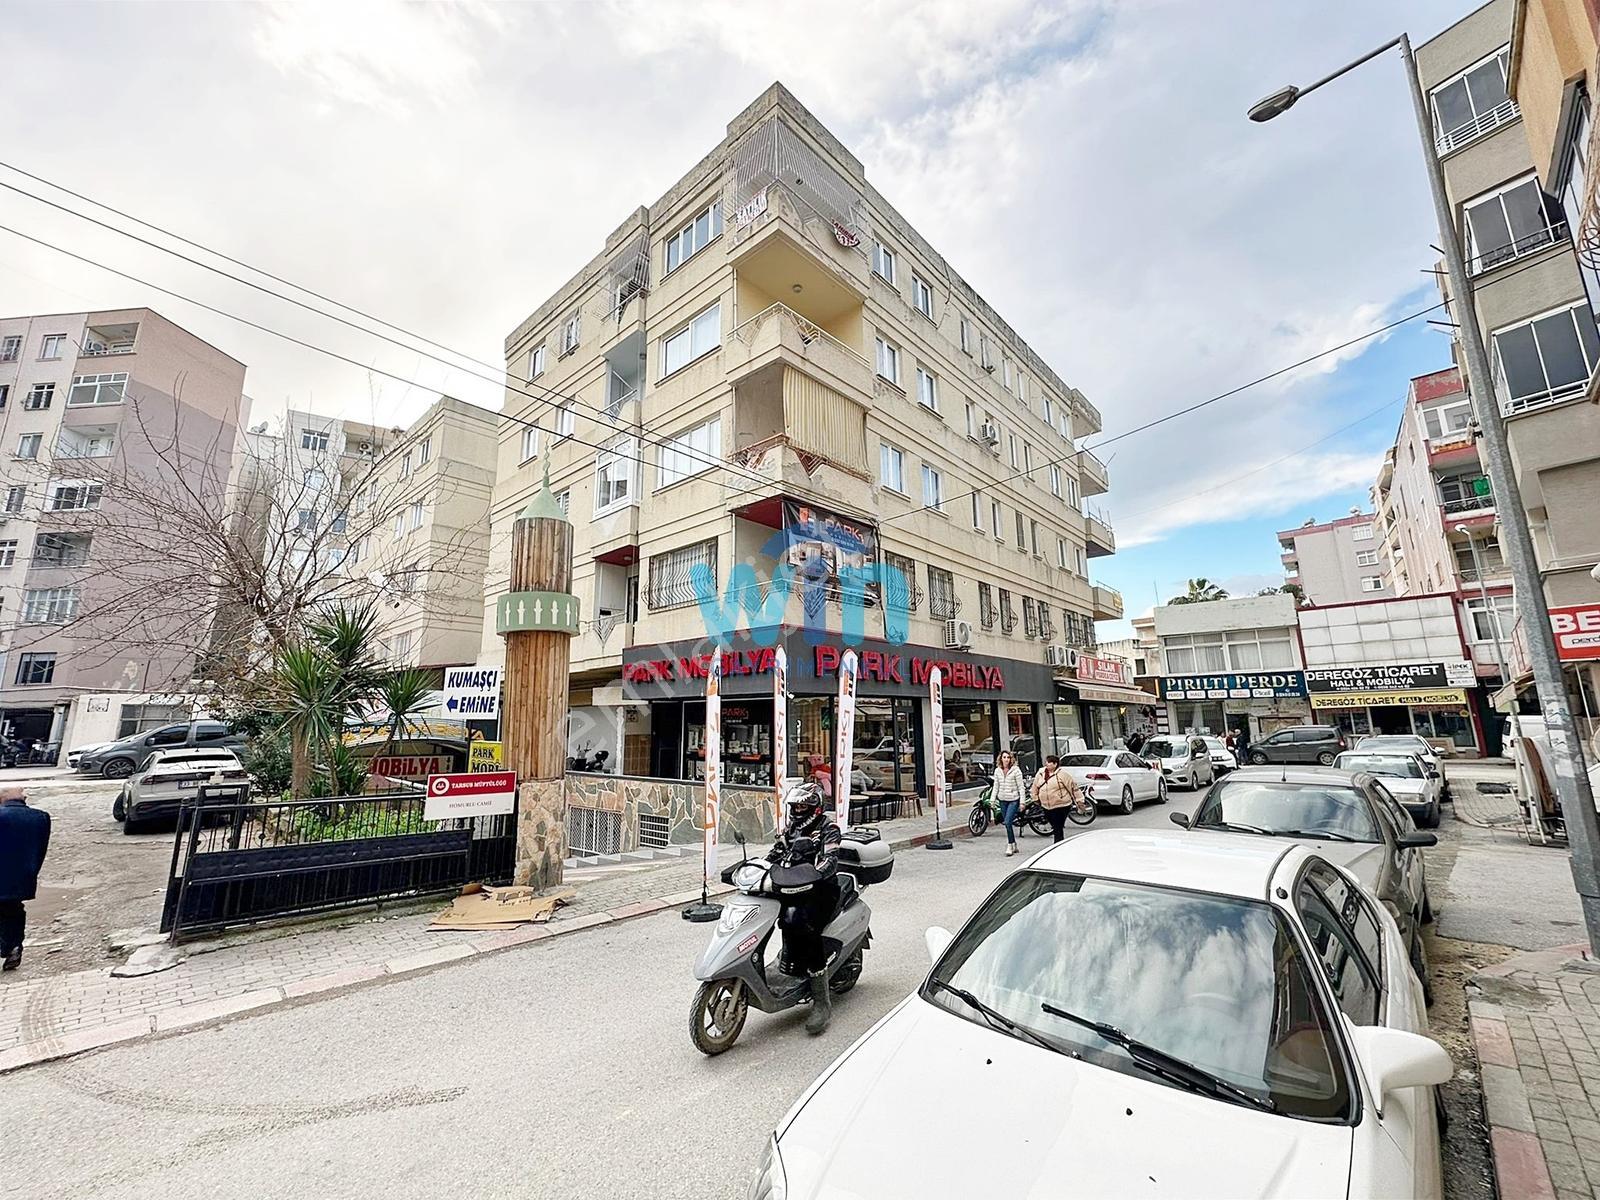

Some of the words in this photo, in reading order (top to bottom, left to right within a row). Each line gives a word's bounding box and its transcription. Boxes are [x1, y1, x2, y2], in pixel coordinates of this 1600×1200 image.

[624, 659, 674, 683] PARK
[911, 655, 1005, 689] MOBİLYA
[1305, 666, 1373, 682] DEREGÖZ
[1374, 665, 1439, 679] TİCARET
[447, 670, 498, 692] KUMAŞÇI
[1166, 677, 1229, 691] PIRILTI
[1235, 674, 1298, 688] PERDE
[1329, 679, 1354, 689] HALI
[1356, 679, 1364, 687] &
[458, 695, 496, 713] EMİNE
[1316, 696, 1356, 707] DEREGÖZ
[1357, 694, 1396, 705] TİCARET
[472, 747, 495, 759] PARK
